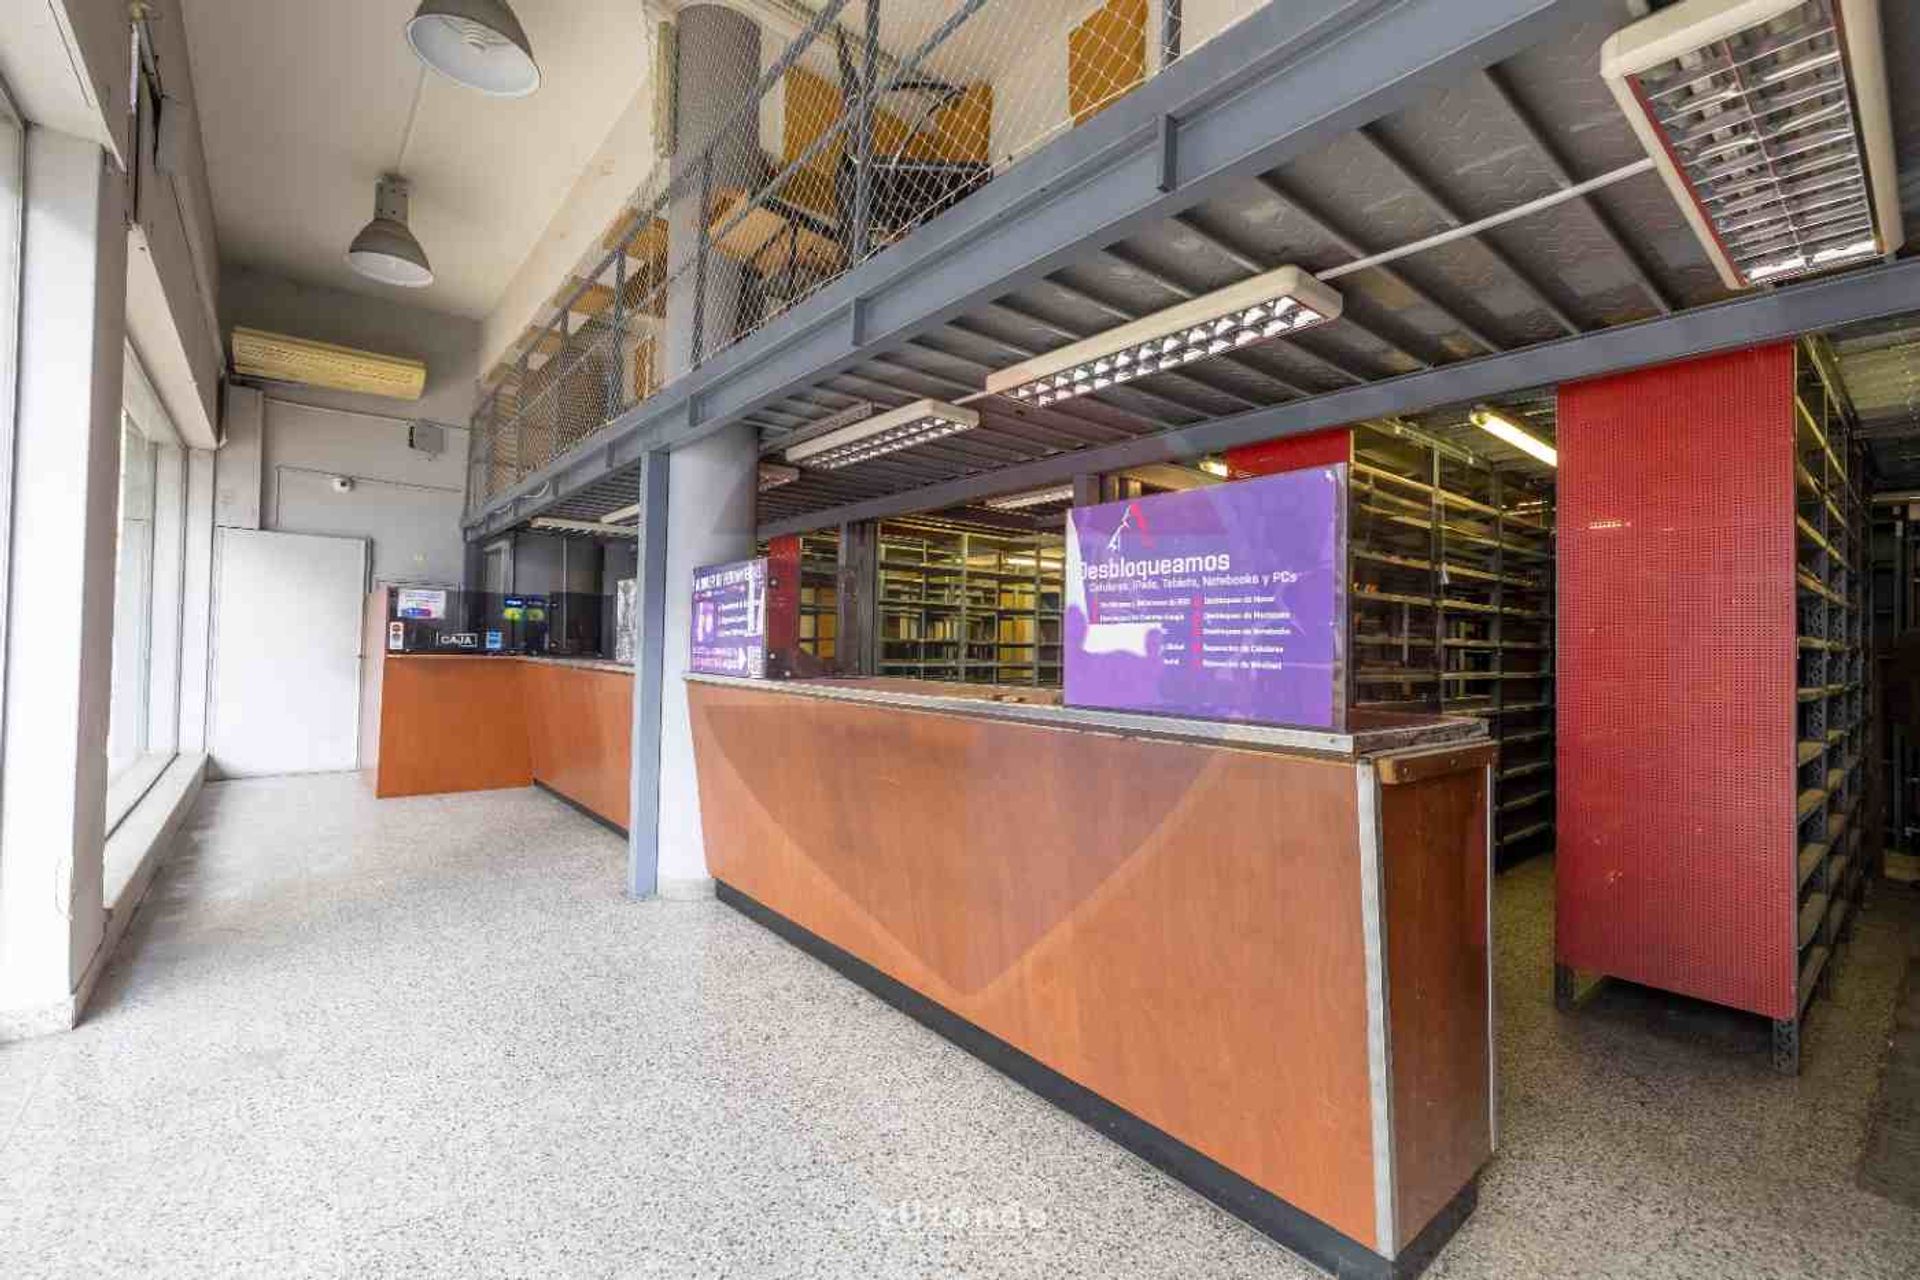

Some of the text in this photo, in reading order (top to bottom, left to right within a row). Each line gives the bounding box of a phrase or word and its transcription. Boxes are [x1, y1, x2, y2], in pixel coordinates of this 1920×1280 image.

[1203, 573, 1259, 587] Notebooks
[1262, 574, 1269, 587] y
[1272, 570, 1298, 583] PCs
[440, 636, 473, 645] CAJA
